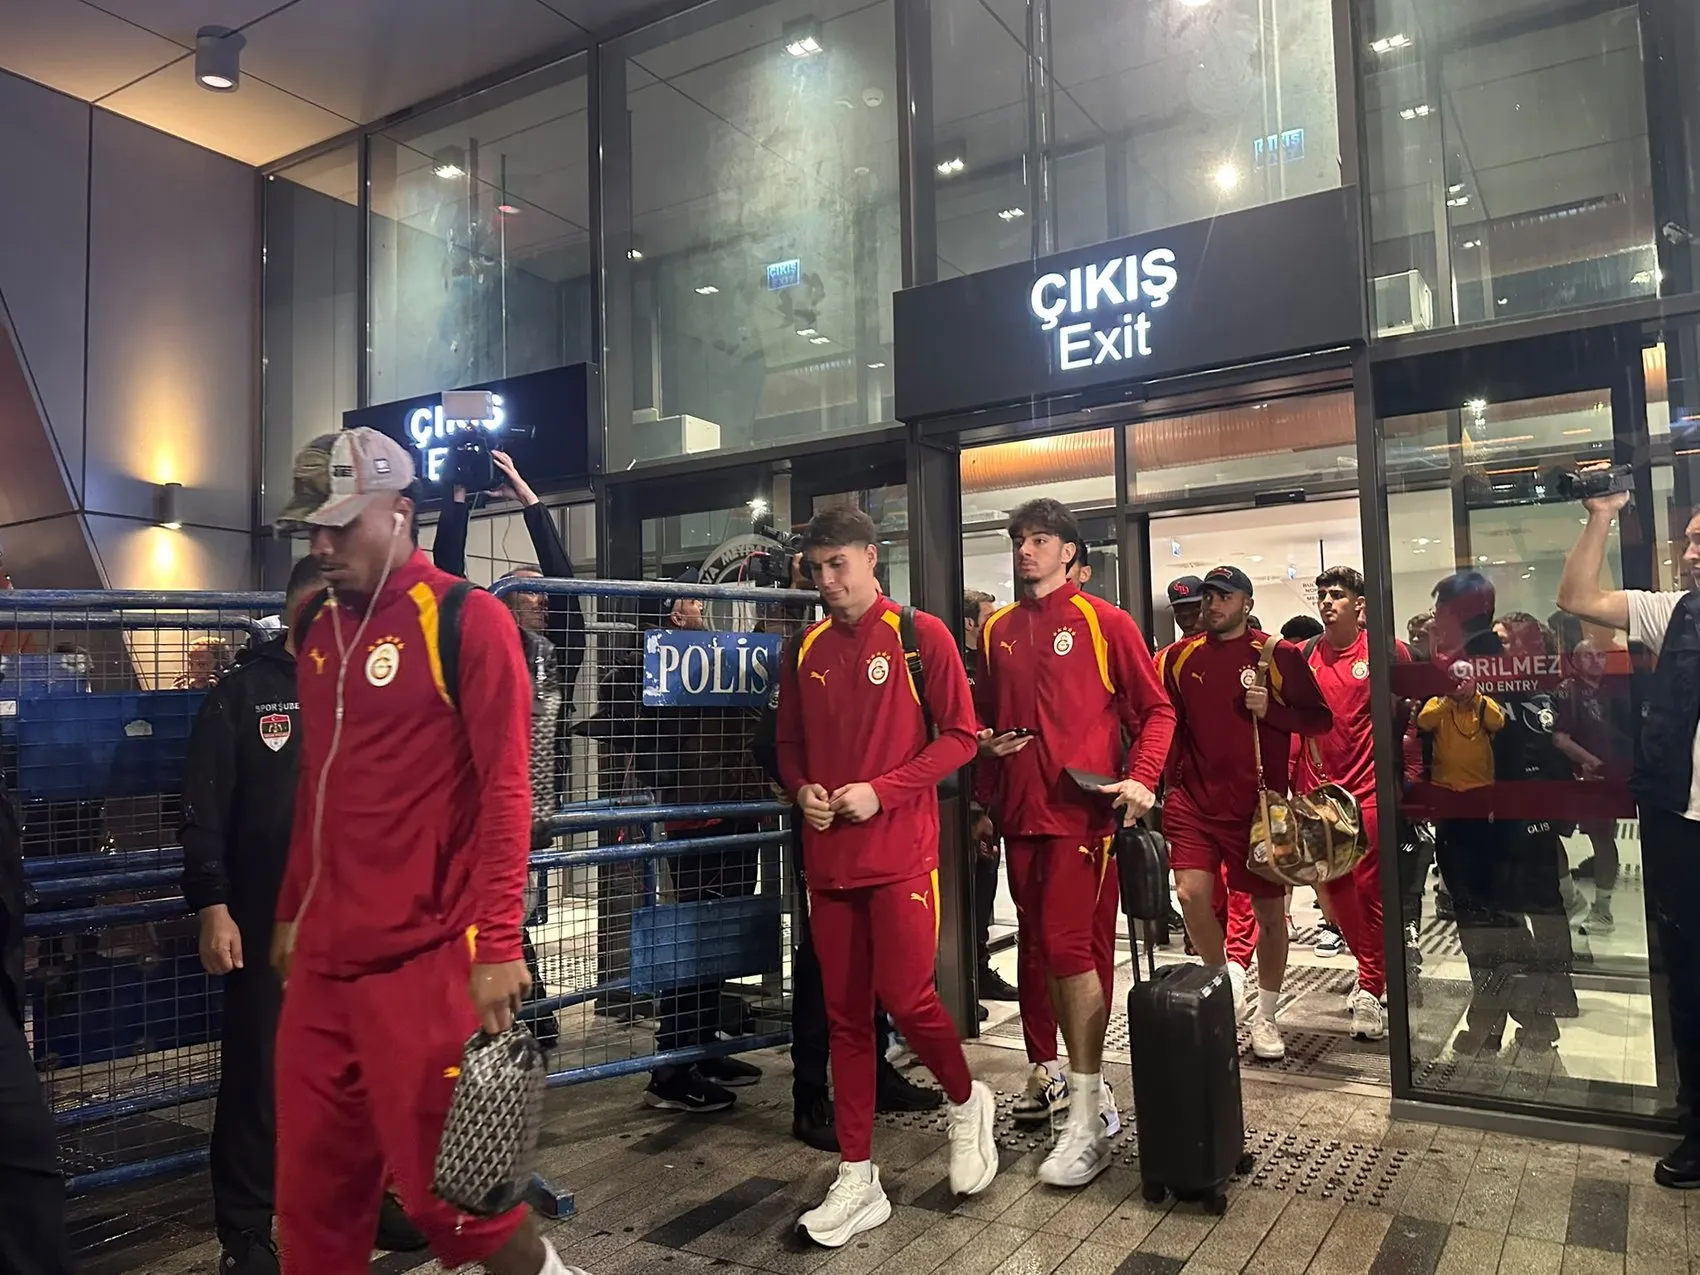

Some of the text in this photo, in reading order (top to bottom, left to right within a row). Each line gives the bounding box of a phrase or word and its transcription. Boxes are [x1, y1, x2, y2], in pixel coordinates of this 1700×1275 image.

[1030, 247, 1179, 331] ÇIKIŞ
[1058, 312, 1153, 371] Exit
[657, 637, 769, 694] POLİS
[1476, 680, 1539, 692] NO ENTRY
[255, 703, 278, 713] SPOR
